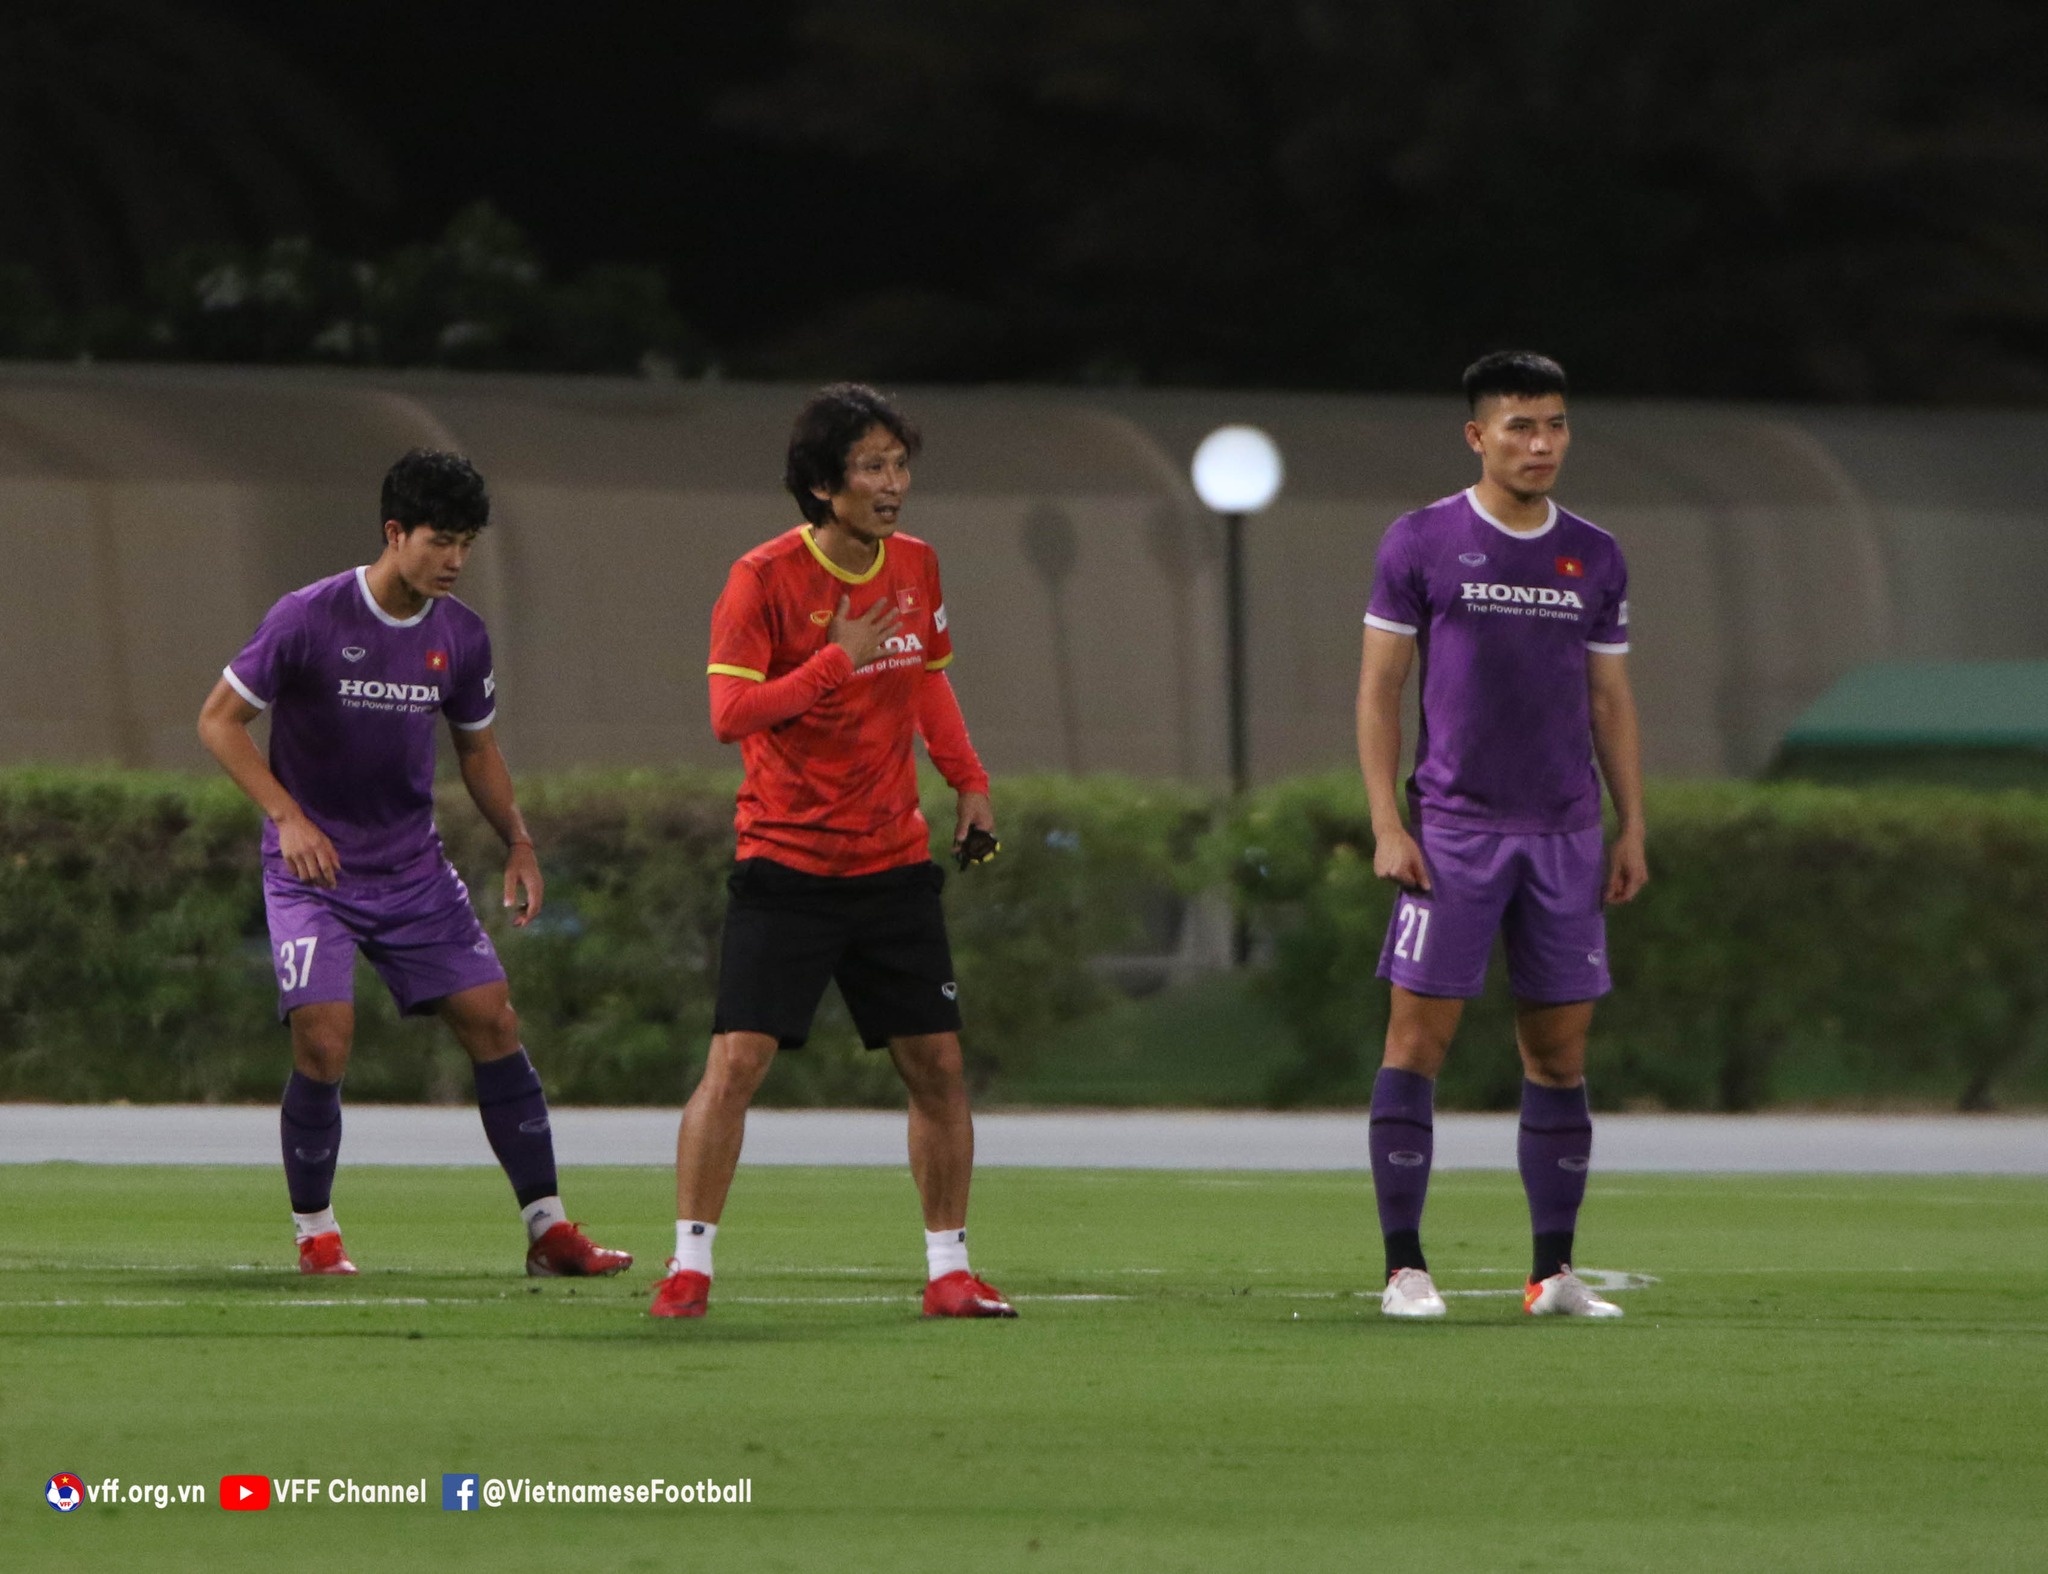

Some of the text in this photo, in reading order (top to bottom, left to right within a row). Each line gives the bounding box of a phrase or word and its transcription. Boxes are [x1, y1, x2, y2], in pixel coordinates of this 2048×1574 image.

[1461, 583, 1583, 609] HONDA
[1467, 603, 1579, 621] The Power of Dreams
[876, 660, 887, 670] of
[888, 655, 922, 669] Dreams
[338, 679, 440, 702] HONDA
[342, 698, 361, 708] The
[362, 699, 395, 711] Power
[396, 703, 407, 712] of
[1394, 902, 1430, 963] 21
[280, 936, 318, 992] 37
